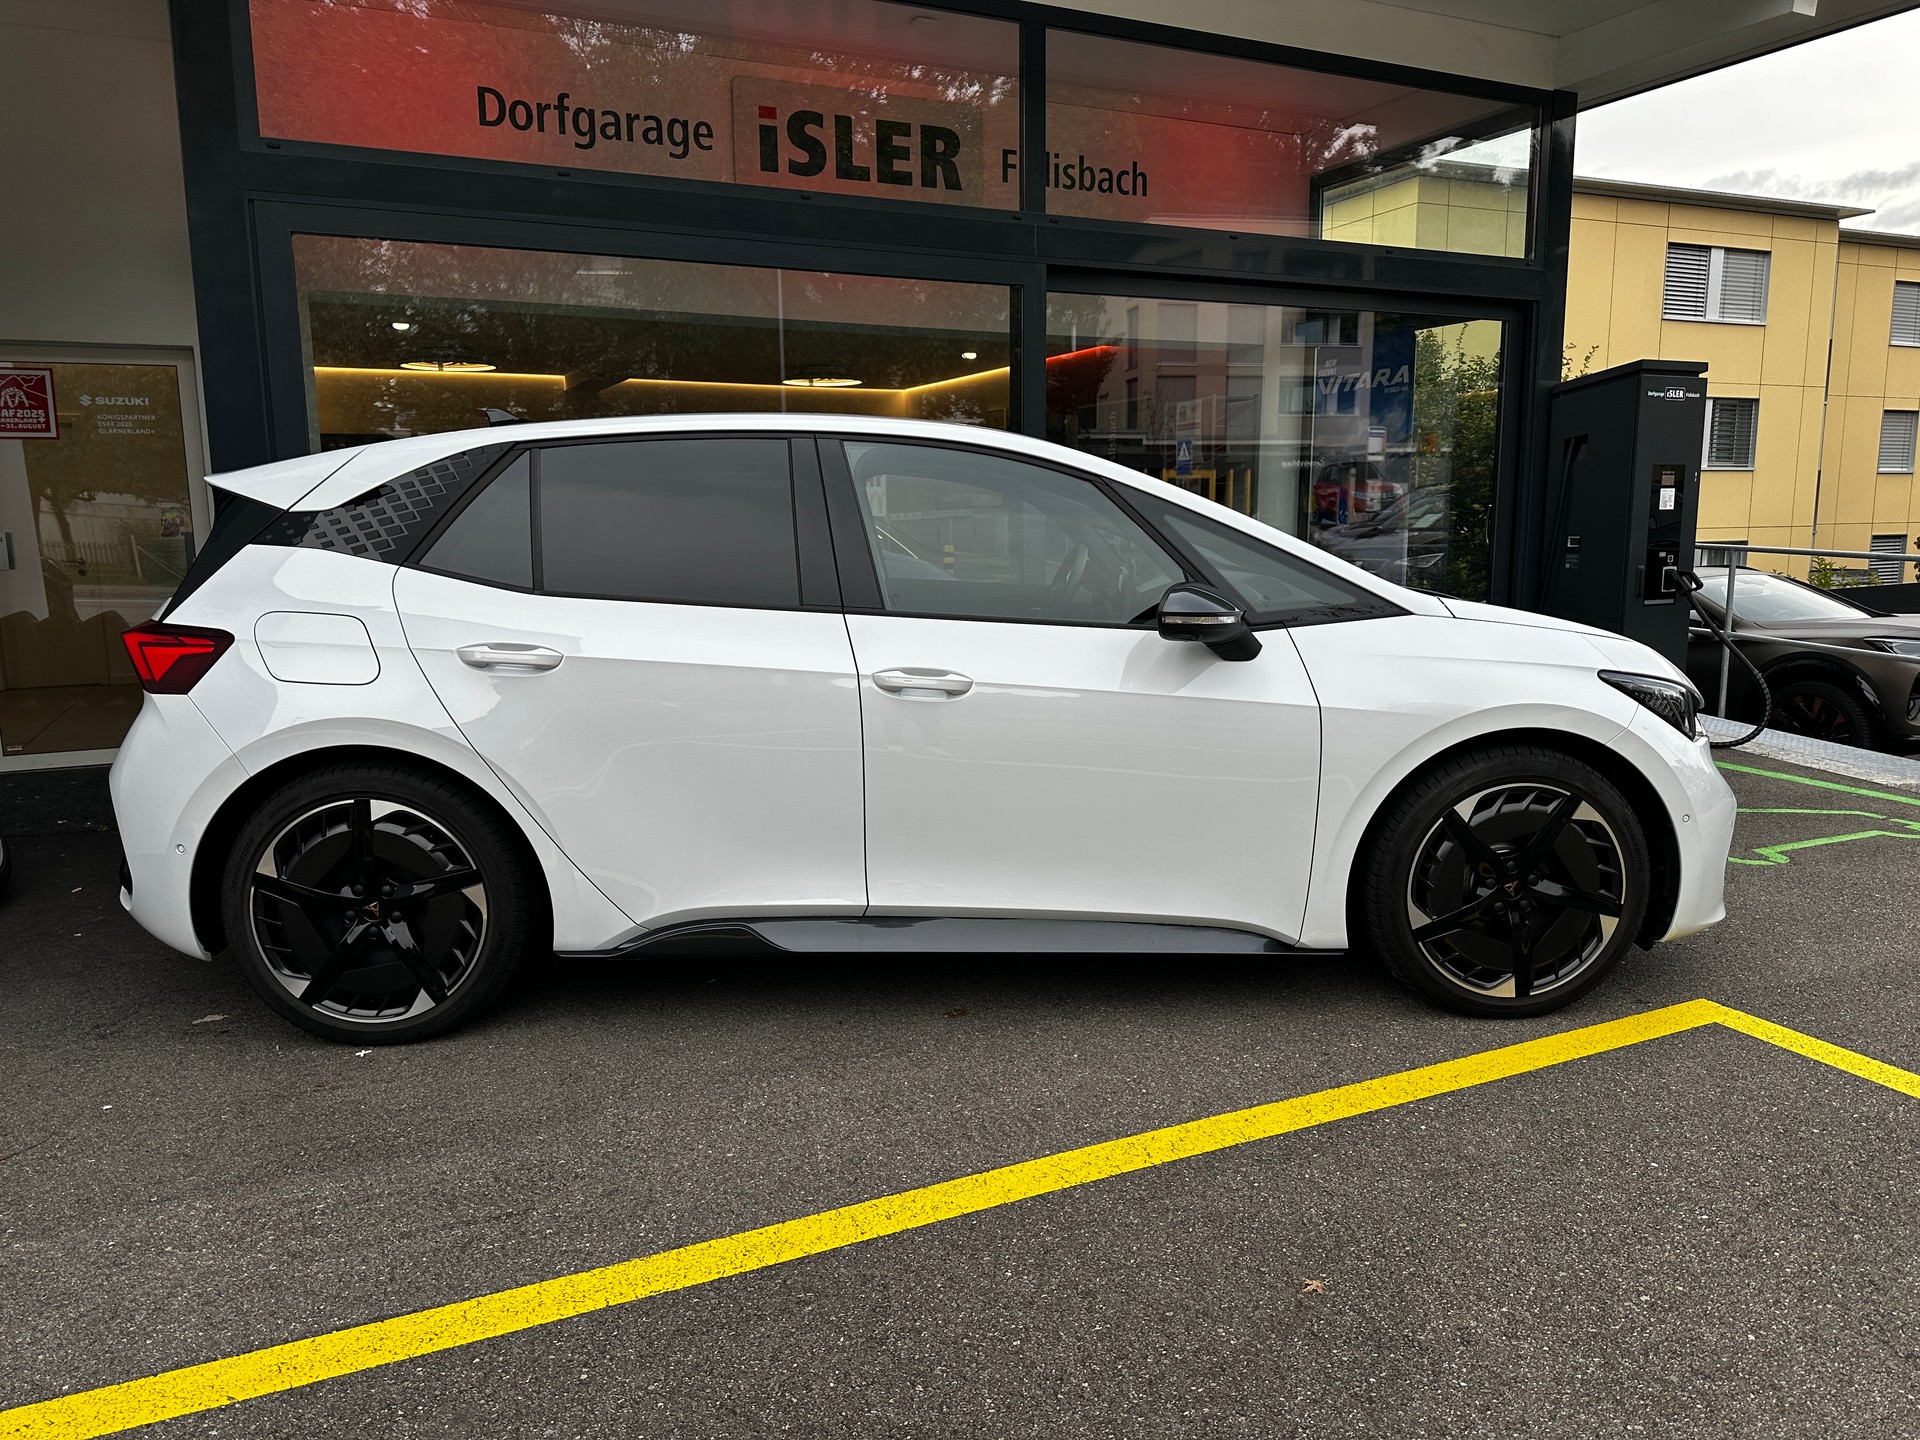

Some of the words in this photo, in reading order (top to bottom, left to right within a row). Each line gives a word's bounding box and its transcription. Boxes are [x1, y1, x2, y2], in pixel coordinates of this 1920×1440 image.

[476, 85, 714, 160] Dorfgarage
[758, 105, 963, 191] iSLER
[1002, 148, 1148, 197] Flisbach
[1317, 364, 1409, 395] VITARA
[95, 396, 150, 406] SUZUKI
[0, 409, 45, 418] AF2025
